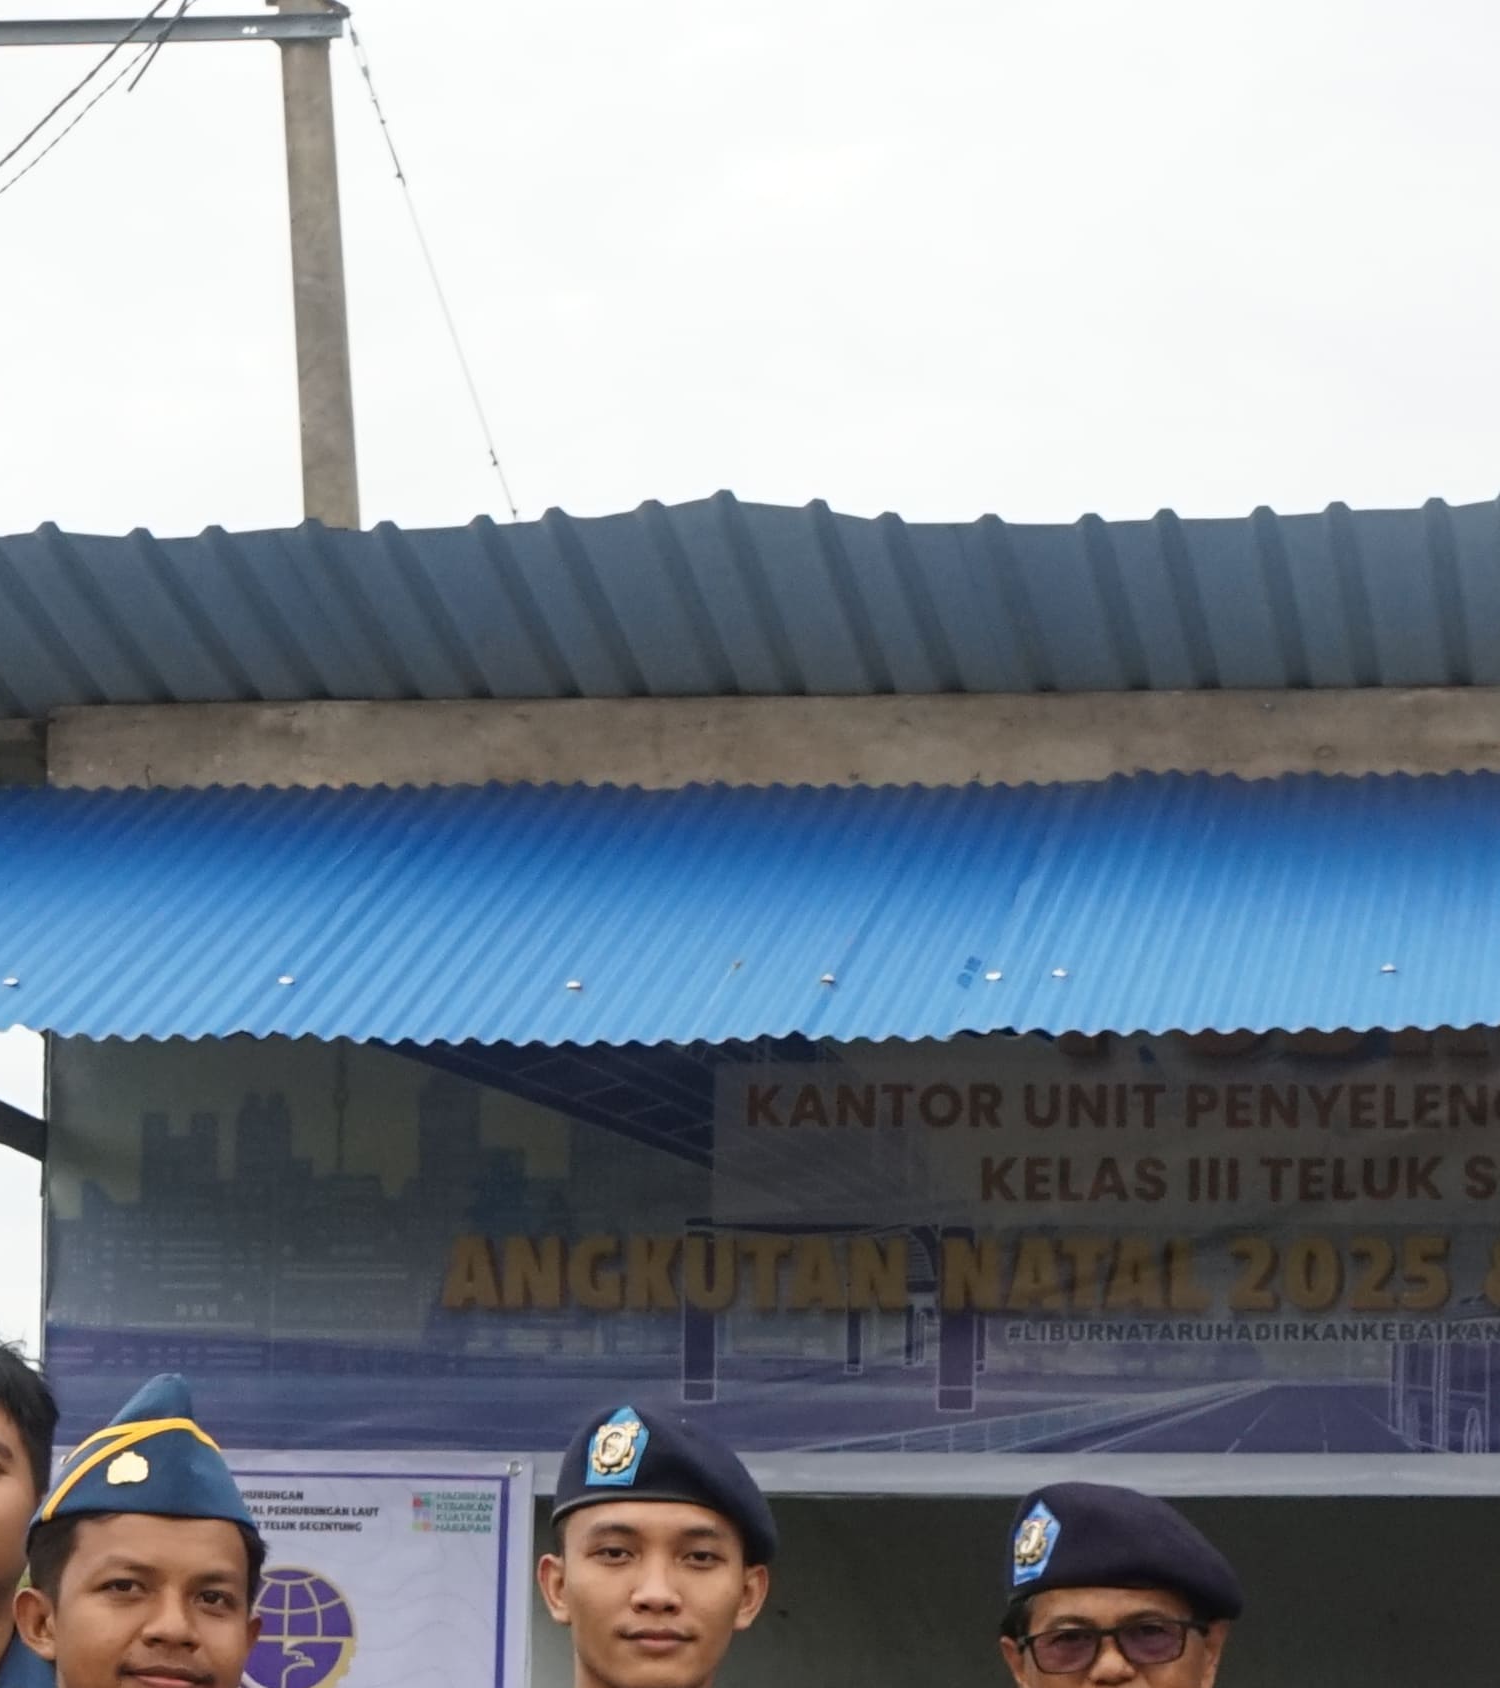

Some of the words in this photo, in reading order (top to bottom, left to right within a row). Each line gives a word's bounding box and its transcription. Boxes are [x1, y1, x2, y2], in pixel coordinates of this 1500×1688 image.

[749, 1083, 1003, 1130] KANTOR
[1026, 1083, 1169, 1130] UNIT
[980, 1156, 1168, 1202] KELAS
[1189, 1156, 1240, 1202] III
[1261, 1156, 1442, 1201] TELUK
[442, 1232, 913, 1312] ANGKUTAN
[943, 1232, 1210, 1311] NATAL
[1228, 1234, 1451, 1312] 2025
[351, 1506, 380, 1517] LAUT
